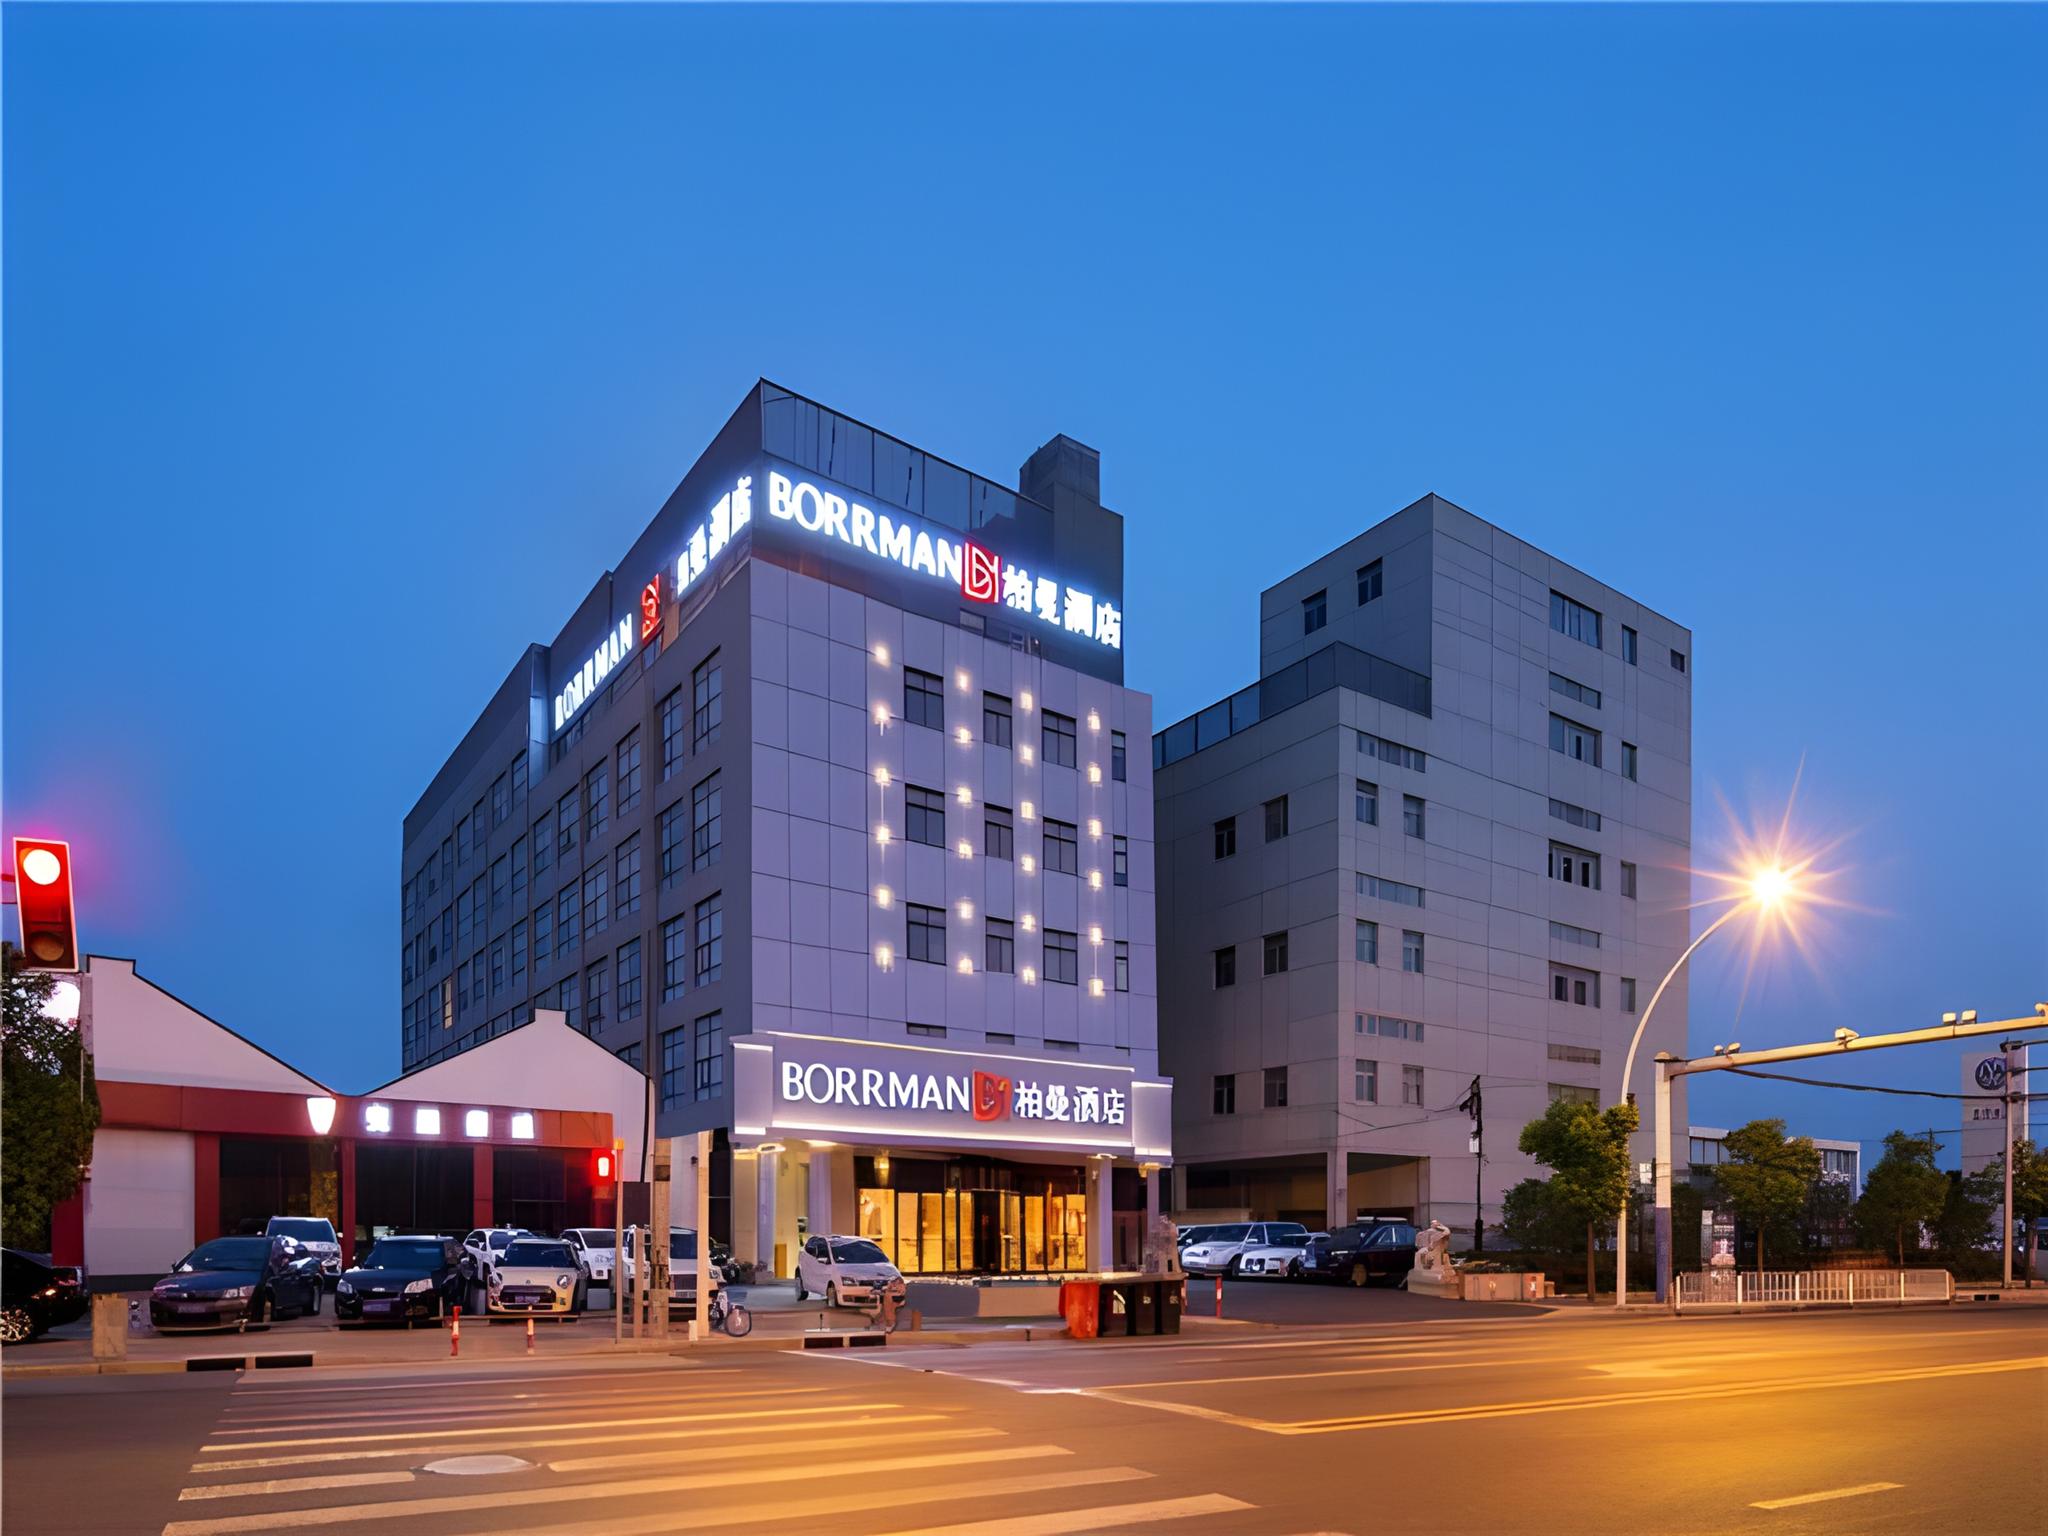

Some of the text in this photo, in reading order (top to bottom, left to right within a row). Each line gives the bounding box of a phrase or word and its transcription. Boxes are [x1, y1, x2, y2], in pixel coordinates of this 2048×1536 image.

[769, 471, 963, 586] BORRMAN
[781, 1061, 969, 1112] BORRMAN
[1014, 1080, 1125, 1125] 柏曼酒店
